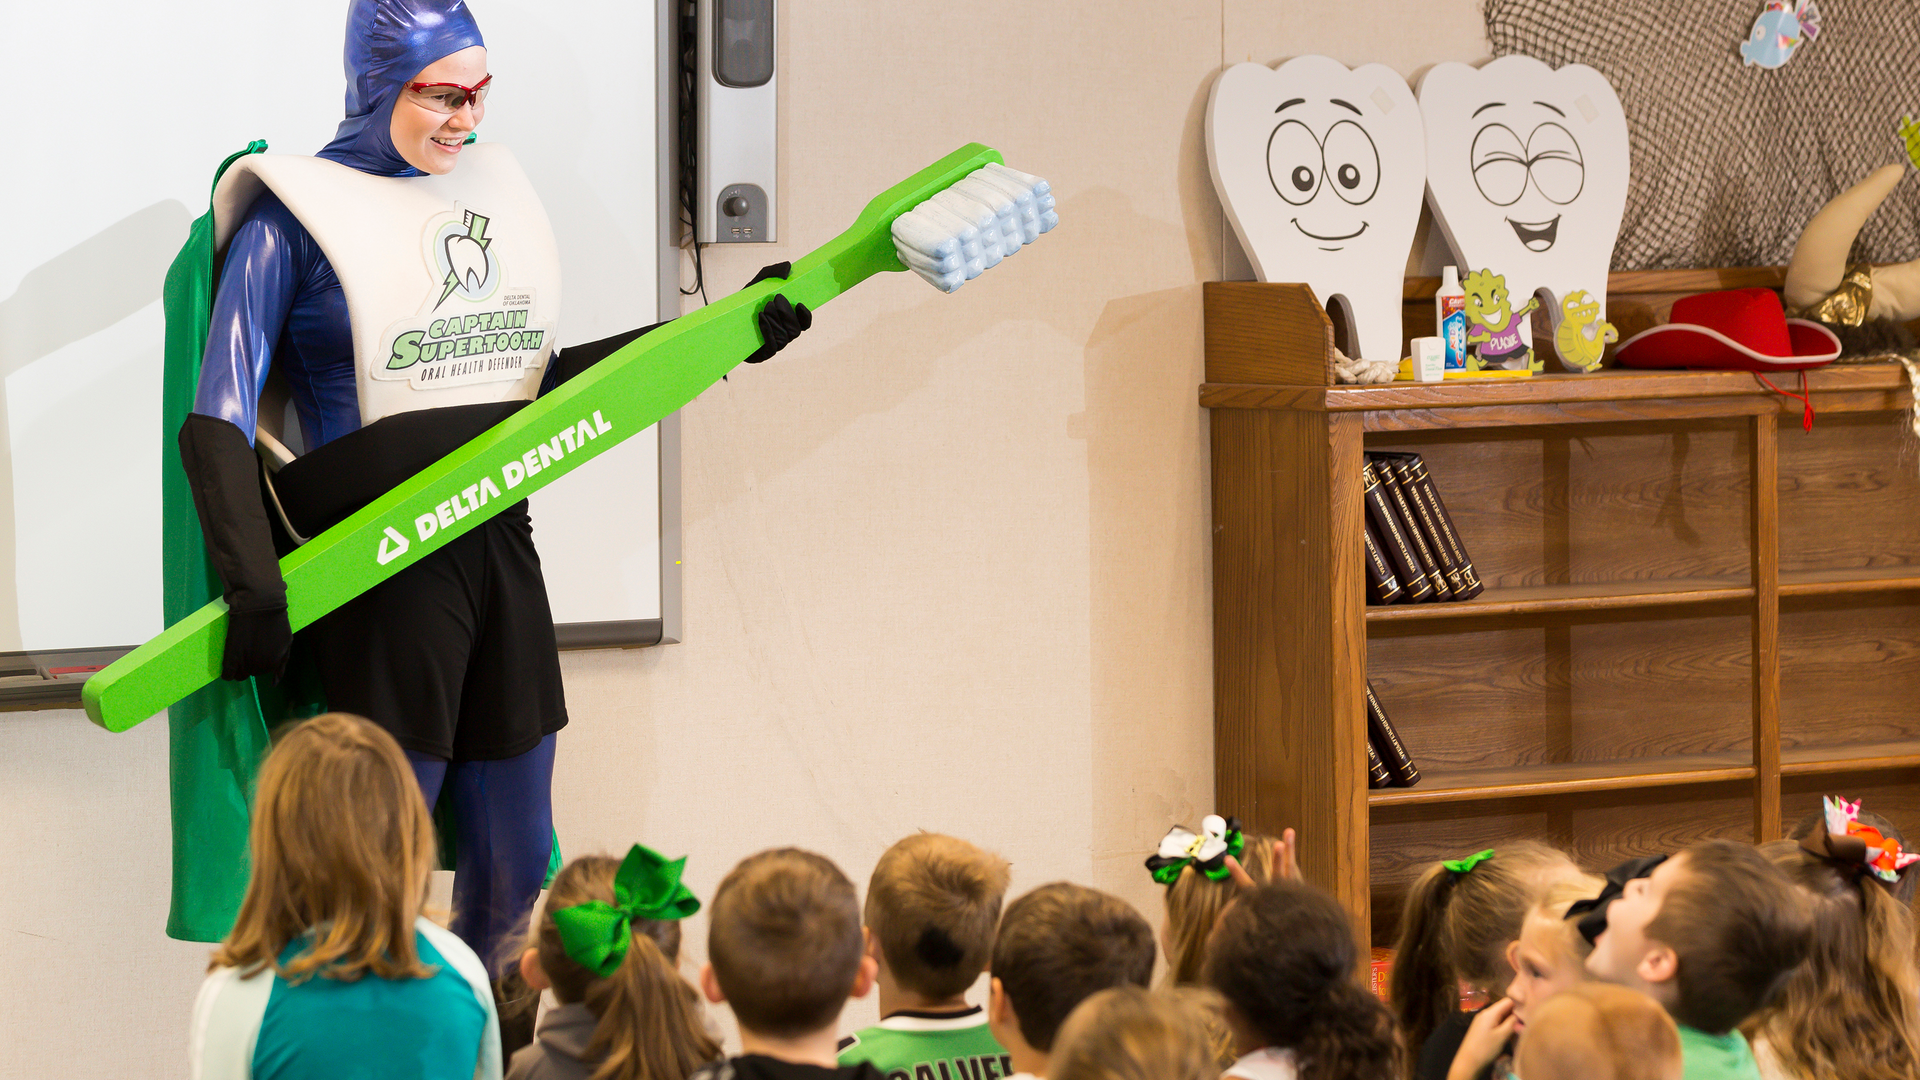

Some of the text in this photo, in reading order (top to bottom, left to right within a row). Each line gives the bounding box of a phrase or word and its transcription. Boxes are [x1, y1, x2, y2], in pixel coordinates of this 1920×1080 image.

[429, 310, 528, 339] CAPTAIN
[386, 330, 544, 370] SUPERTOOTH
[1455, 316, 1464, 367] Crest
[1489, 333, 1519, 351] PLAQUE
[421, 356, 523, 381] ORAL HEALTH DEFENDER
[414, 410, 613, 542] DELTA DENTAL
[1464, 570, 1476, 585] B
